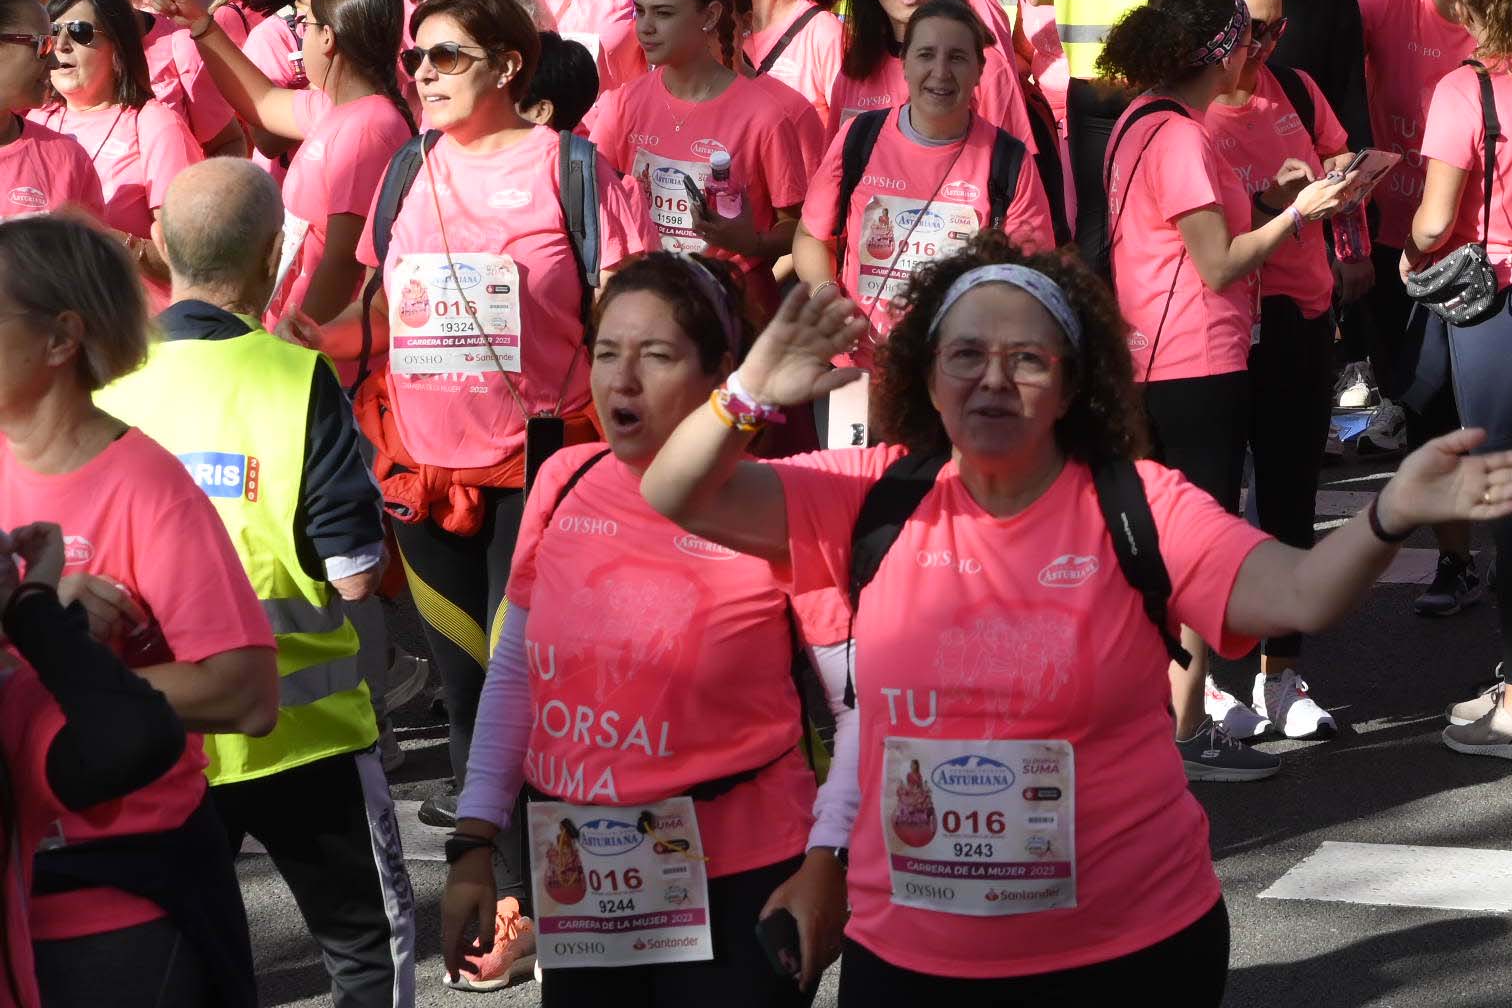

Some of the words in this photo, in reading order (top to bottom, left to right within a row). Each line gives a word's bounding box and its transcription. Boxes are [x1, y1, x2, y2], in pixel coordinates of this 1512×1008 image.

[1392, 114, 1417, 139] TU
[862, 175, 906, 191] OYSHO
[654, 195, 688, 212] 016
[657, 213, 683, 225] 11598
[898, 240, 936, 256] 016
[434, 300, 479, 317] 016
[440, 322, 475, 333] 19324
[407, 337, 442, 346] CARRERA
[442, 337, 454, 346] DE
[455, 336, 466, 345] LA
[404, 354, 443, 365] OYSHO
[558, 515, 619, 537] OYSHO
[880, 687, 937, 728] TU
[1022, 764, 1061, 775] SUMA
[937, 770, 1008, 787] ASTURIANA
[654, 819, 684, 831] UMA
[942, 810, 1006, 836] 016
[581, 831, 639, 848] ASTURIANA
[953, 843, 994, 858] 9243
[906, 860, 951, 875] CARRERA
[954, 865, 969, 875] DE
[971, 865, 985, 876] LA
[987, 865, 1026, 876] MUJER
[1030, 865, 1056, 876] 2023
[588, 867, 643, 893] 016
[905, 881, 956, 900] OYSHO
[999, 887, 1061, 902] Santander
[598, 898, 636, 914] 9244
[557, 919, 601, 930] CARRERA
[602, 920, 615, 930] DE
[617, 919, 631, 928] LA
[631, 917, 668, 928] MUJER
[554, 942, 606, 956] OYSHO
[647, 936, 700, 951] Santander
